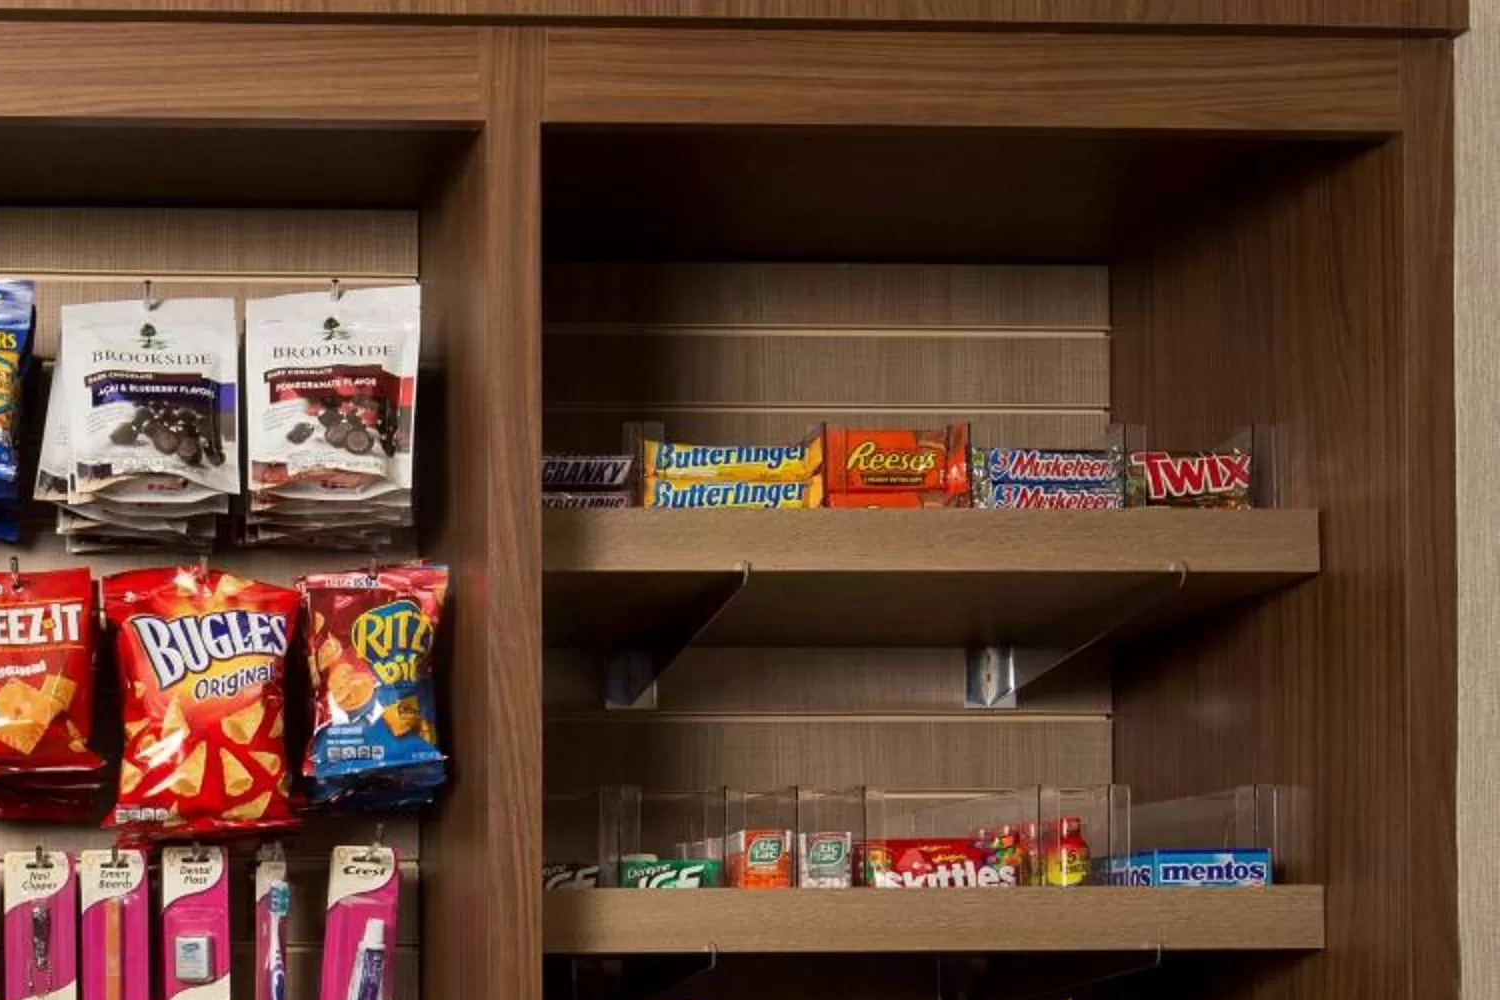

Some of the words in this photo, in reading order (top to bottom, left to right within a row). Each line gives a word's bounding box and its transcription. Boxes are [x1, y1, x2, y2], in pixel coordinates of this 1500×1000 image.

[91, 350, 214, 366] BROOKSIDE
[272, 343, 398, 360] BROOKSIDE
[129, 383, 179, 394] BLUEBERRY
[655, 440, 807, 471] Butterfinger
[1135, 451, 1252, 499] TWIX
[655, 480, 807, 509] Butterfinger
[352, 604, 433, 660] RITZ
[131, 609, 289, 691] BUGLES
[760, 839, 779, 853] tic
[754, 851, 777, 861] tac
[28, 871, 52, 882] Nail
[179, 865, 213, 878] Dental
[342, 865, 387, 879] Crest
[1159, 861, 1265, 882] mentos
[20, 881, 59, 892] Clipper
[183, 875, 208, 886] Floss
